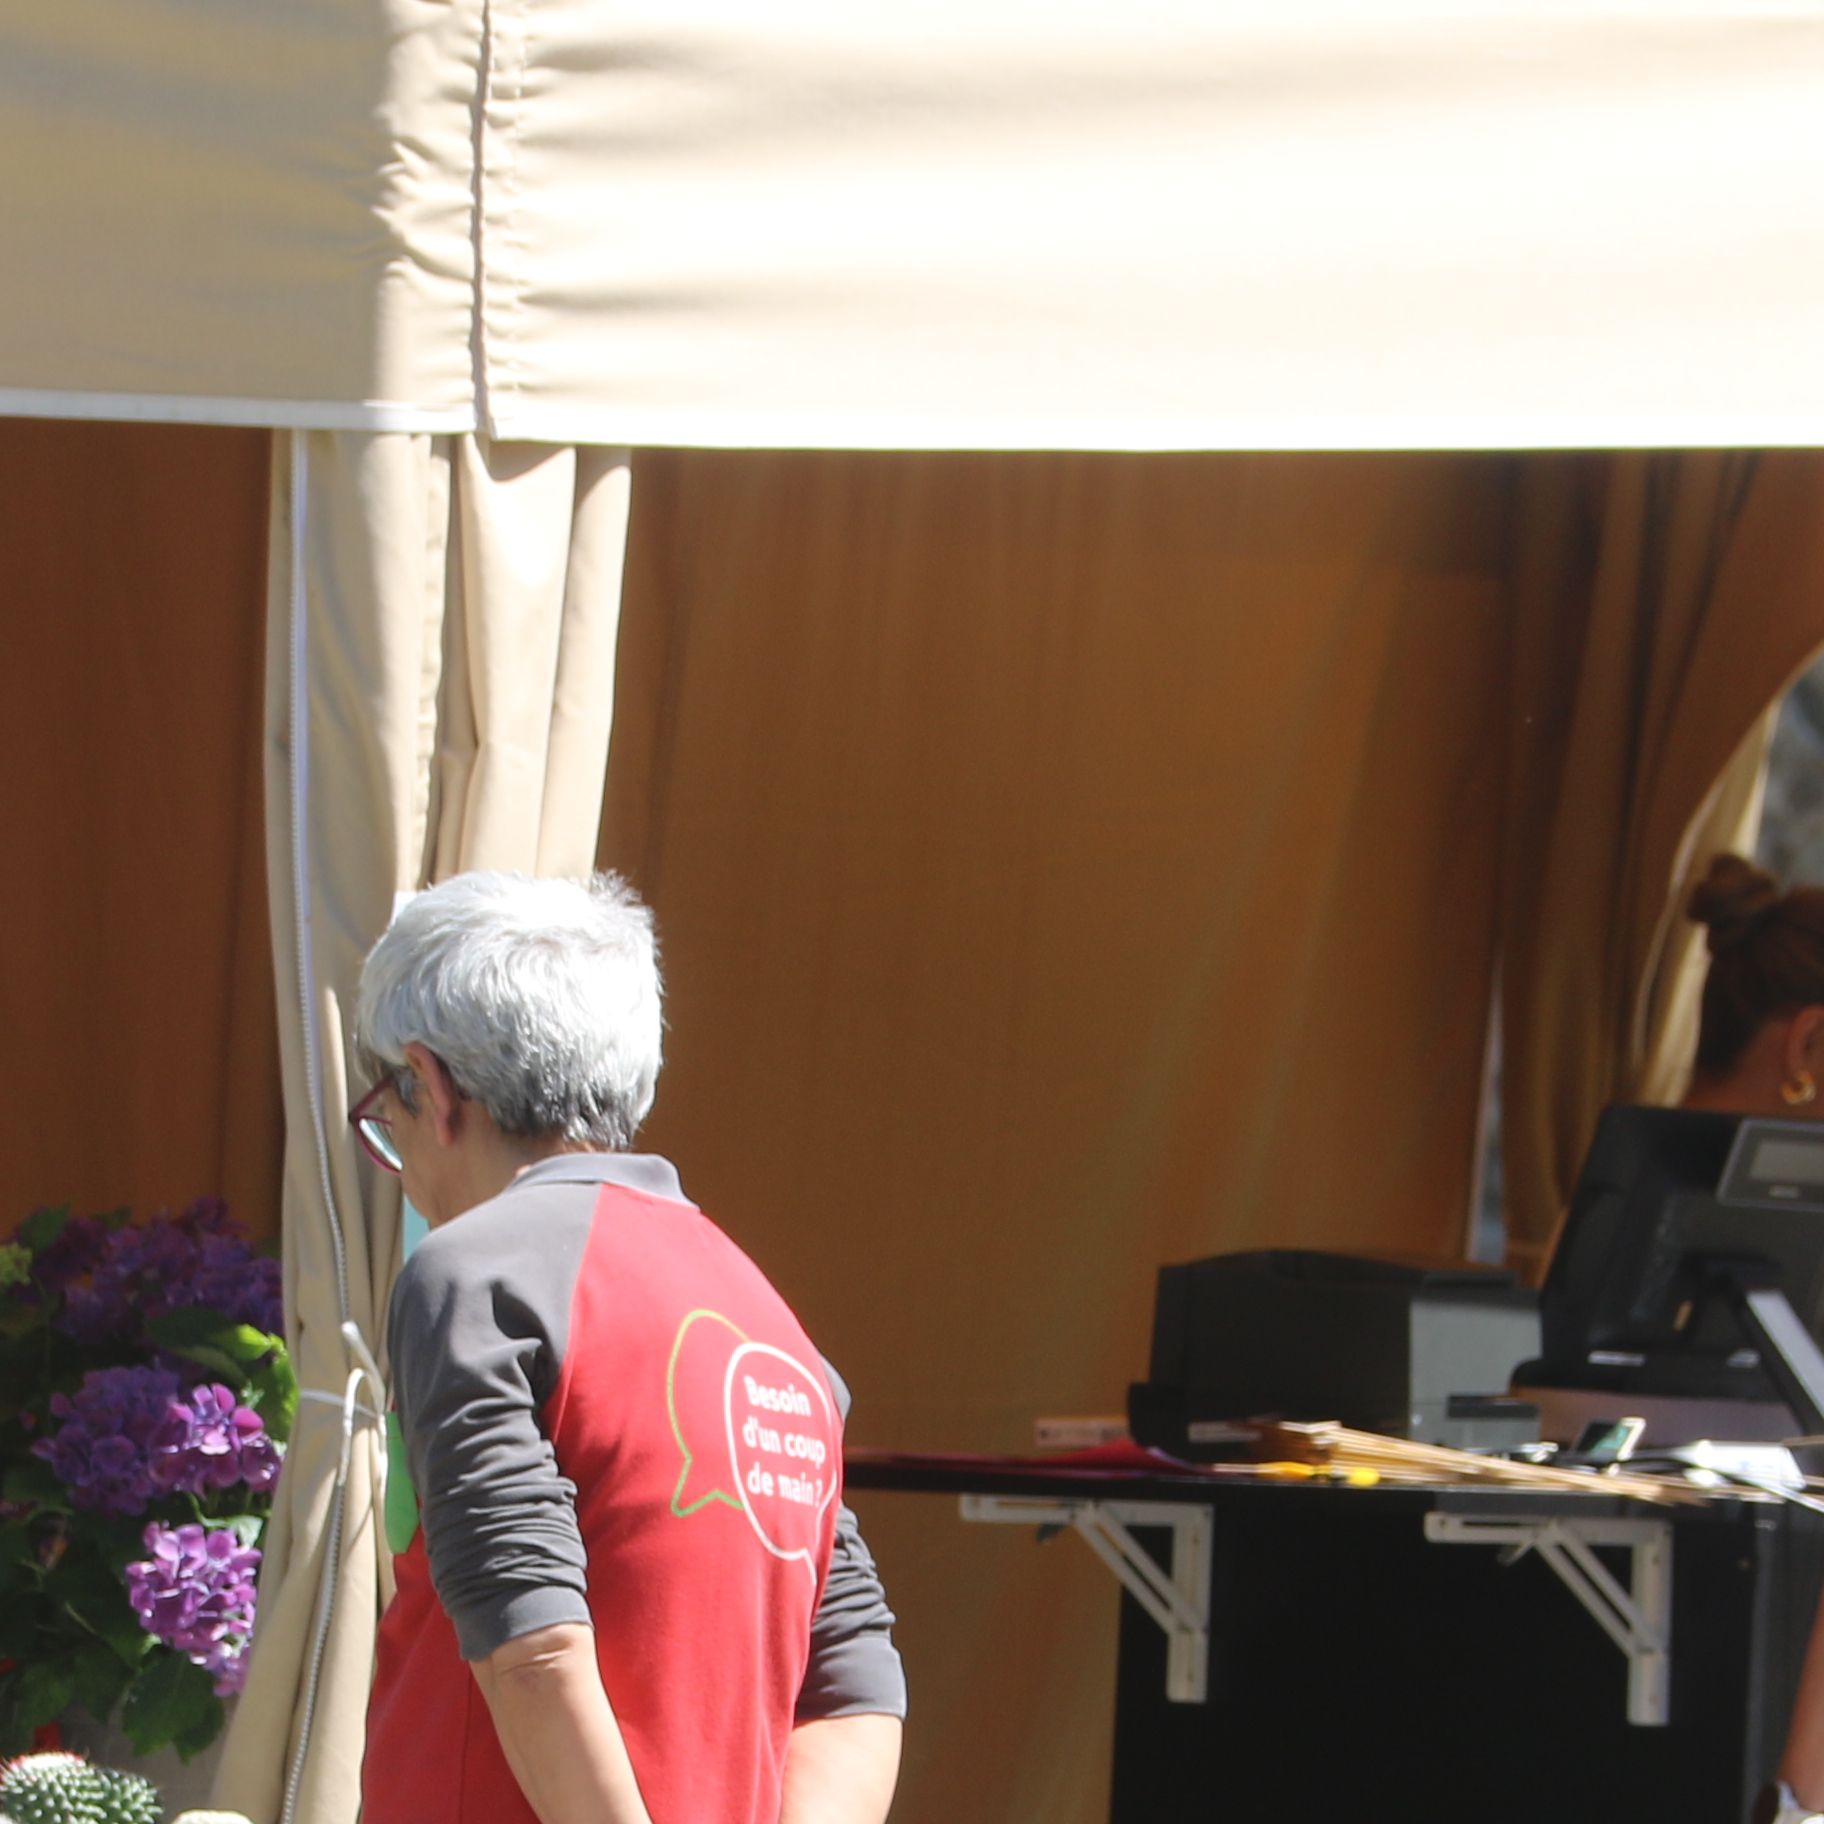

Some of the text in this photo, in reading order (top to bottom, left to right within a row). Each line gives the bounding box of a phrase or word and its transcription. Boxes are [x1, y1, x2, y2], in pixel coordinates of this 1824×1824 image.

[744, 1374, 811, 1416] Besoin
[742, 1415, 826, 1469] d'un coup
[747, 1461, 774, 1496] de
